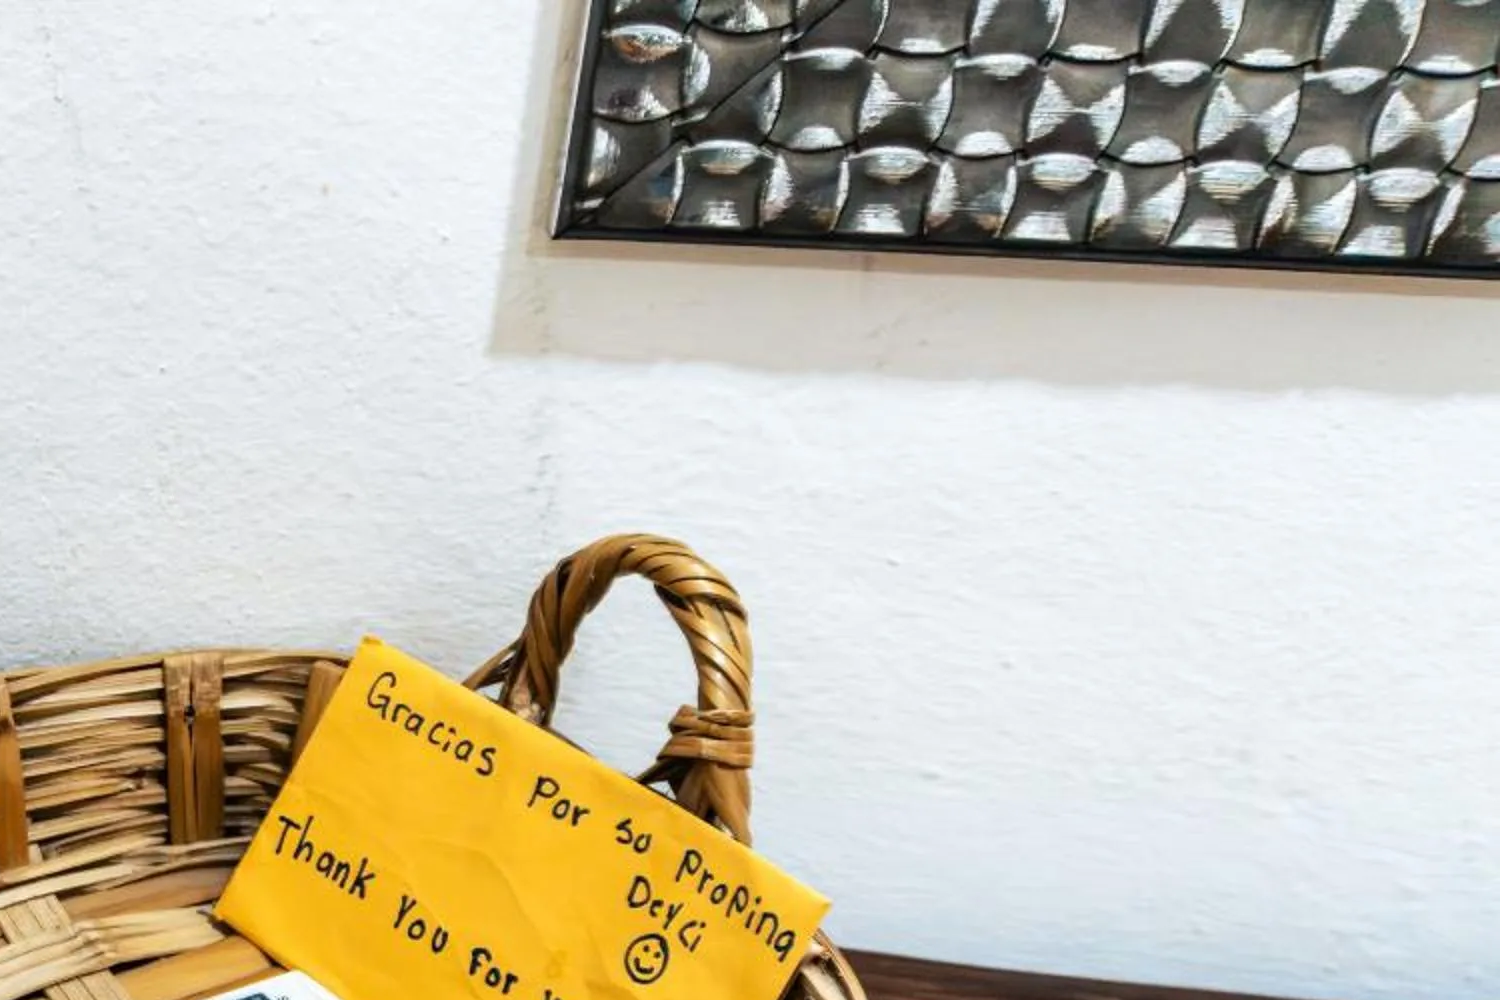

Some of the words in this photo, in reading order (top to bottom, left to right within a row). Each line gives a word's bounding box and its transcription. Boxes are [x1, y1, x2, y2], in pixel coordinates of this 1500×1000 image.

[367, 671, 497, 777] Gracias
[527, 774, 591, 827] Por
[275, 815, 376, 900] Thank
[393, 894, 449, 955] You
